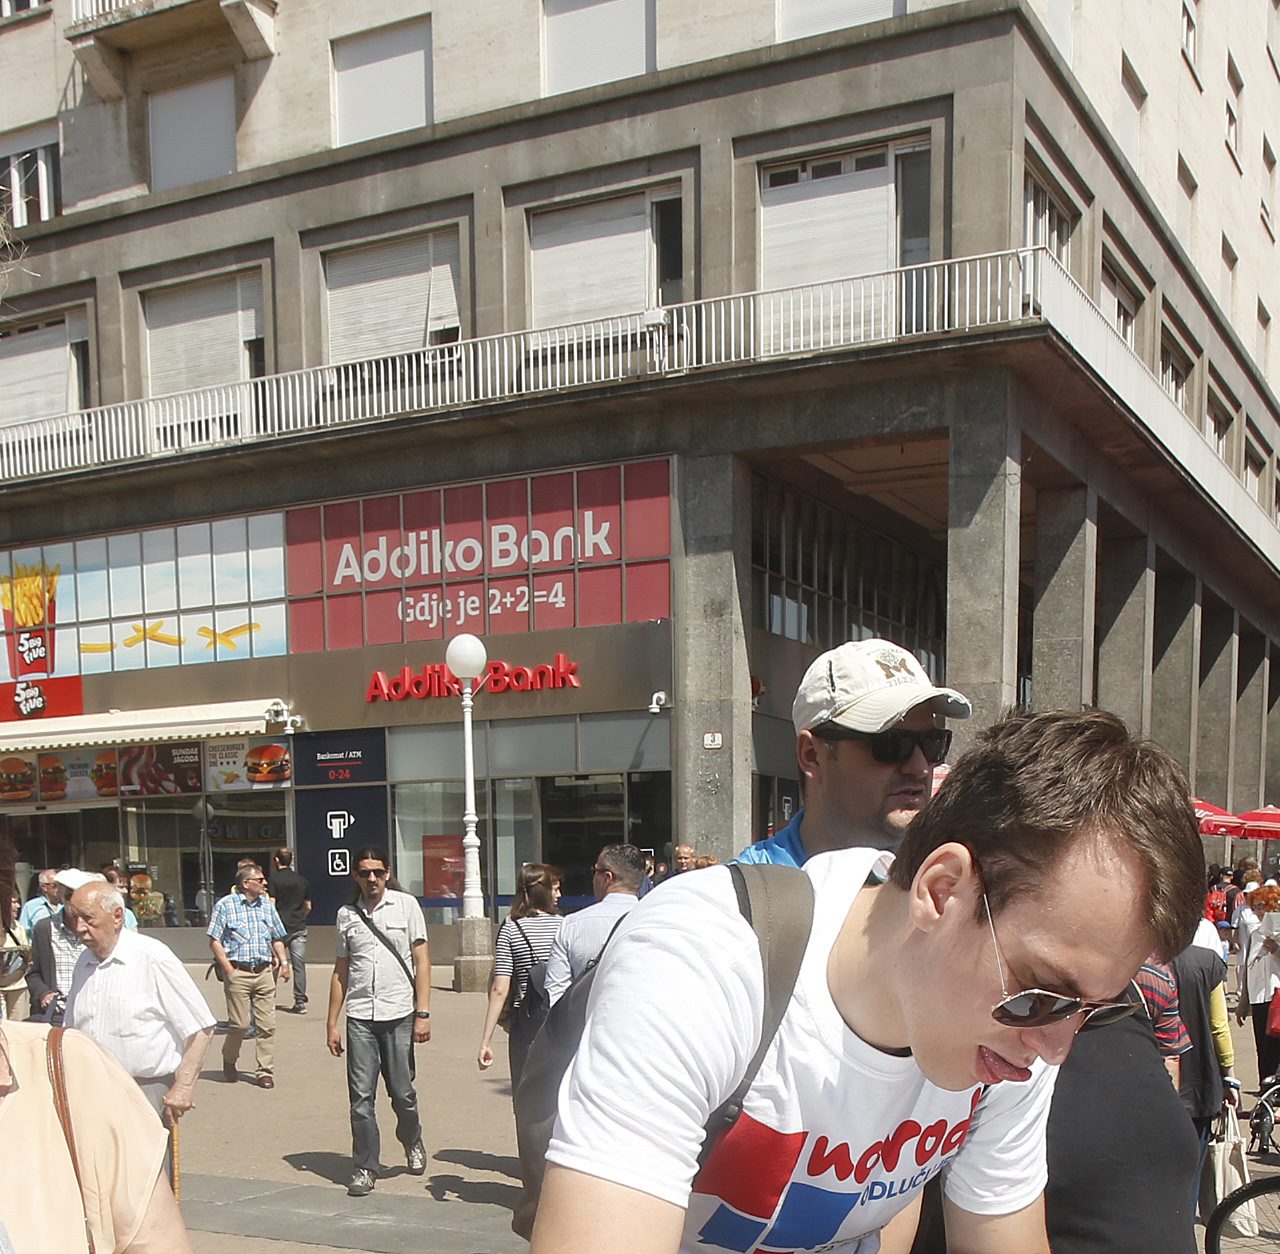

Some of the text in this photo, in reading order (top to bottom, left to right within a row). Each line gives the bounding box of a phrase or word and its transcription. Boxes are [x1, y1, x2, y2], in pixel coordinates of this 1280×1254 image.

[332, 510, 614, 586] Addiko Bank
[397, 581, 567, 628] Gdje je 2+2=4
[18, 632, 30, 652] 5
[486, 652, 582, 694] Bank
[14, 682, 27, 702] 5
[173, 755, 200, 765] JAGODA
[316, 752, 344, 761] Bankomat
[348, 750, 363, 759] ATM
[328, 769, 352, 781] 0-24
[806, 1086, 982, 1185] narod
